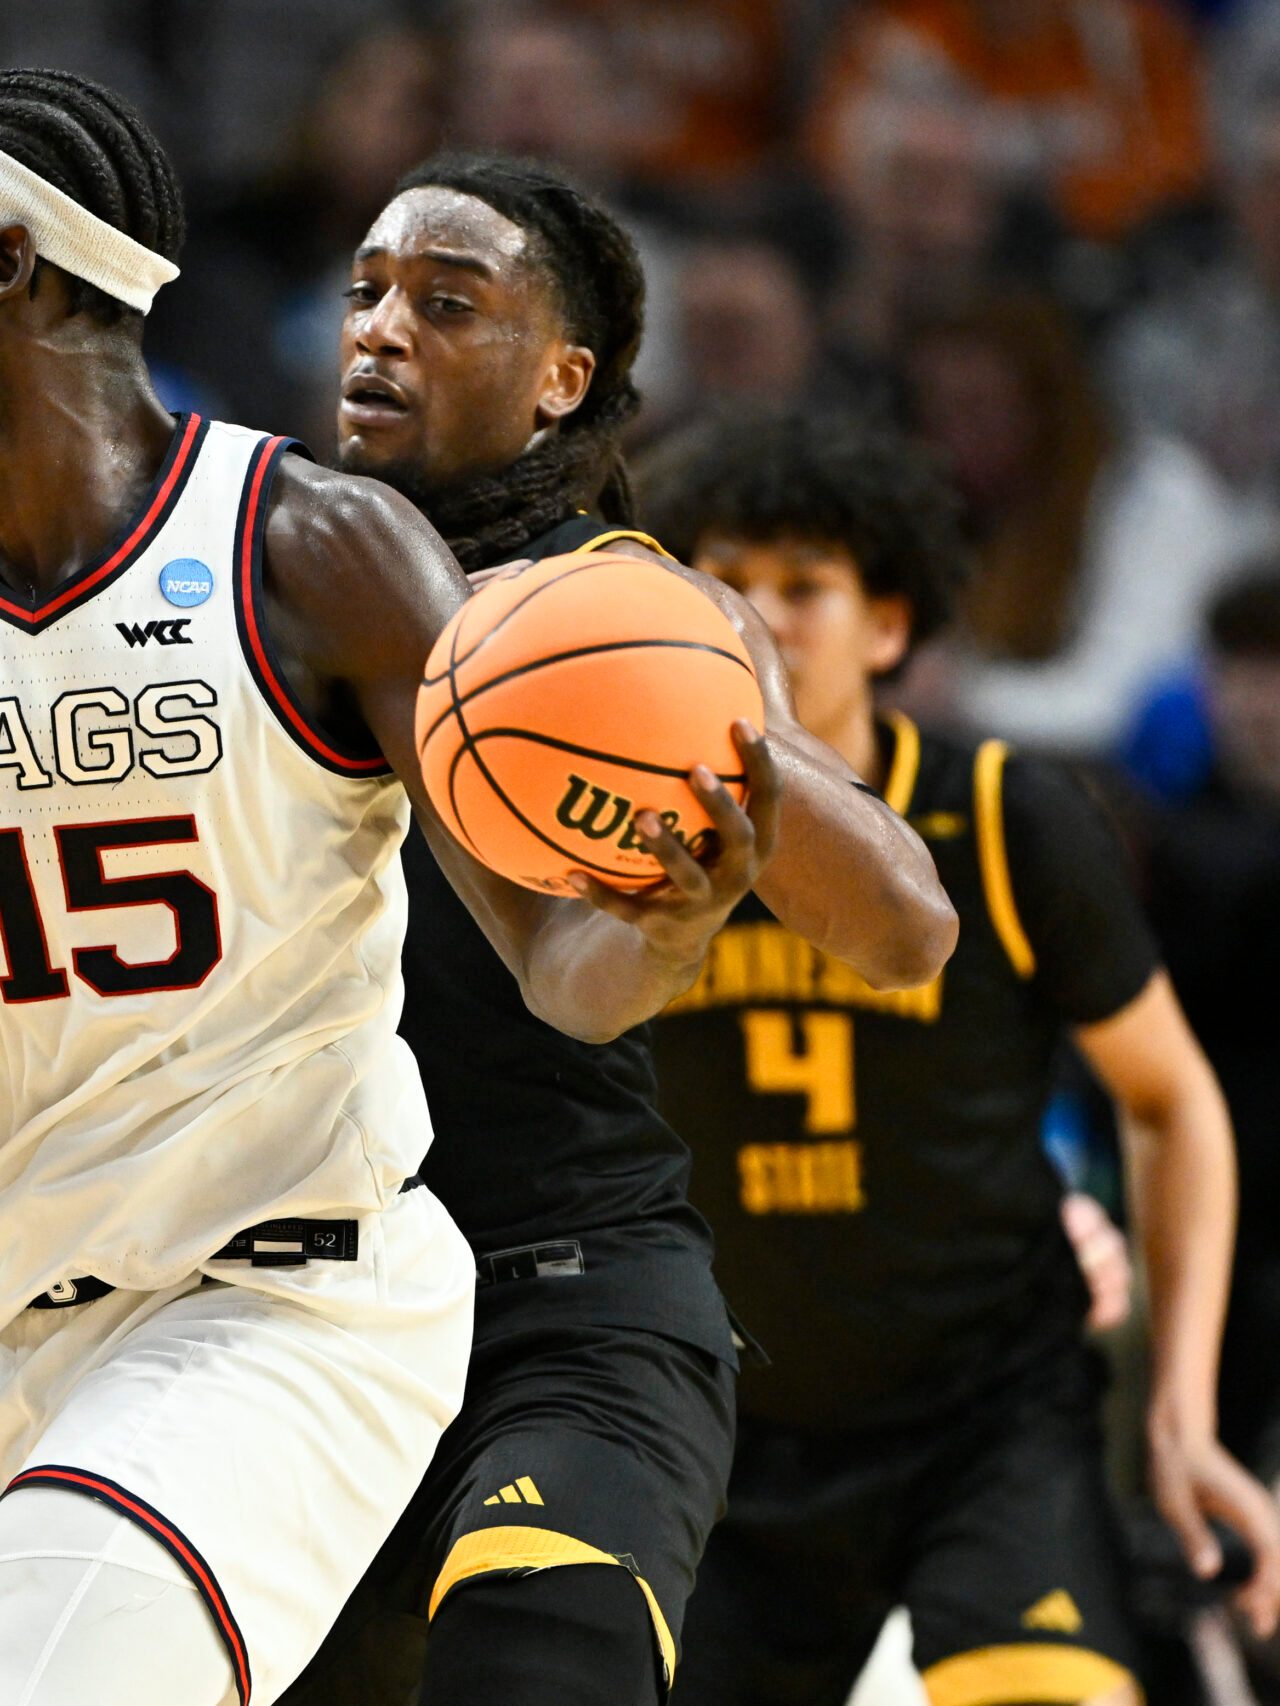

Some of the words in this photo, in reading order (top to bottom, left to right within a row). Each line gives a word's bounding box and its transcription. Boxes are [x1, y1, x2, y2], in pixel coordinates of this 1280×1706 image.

[166, 580, 210, 593] NCAA
[115, 618, 194, 648] WCC
[742, 1008, 856, 1134] 4
[313, 1232, 337, 1248] 52
